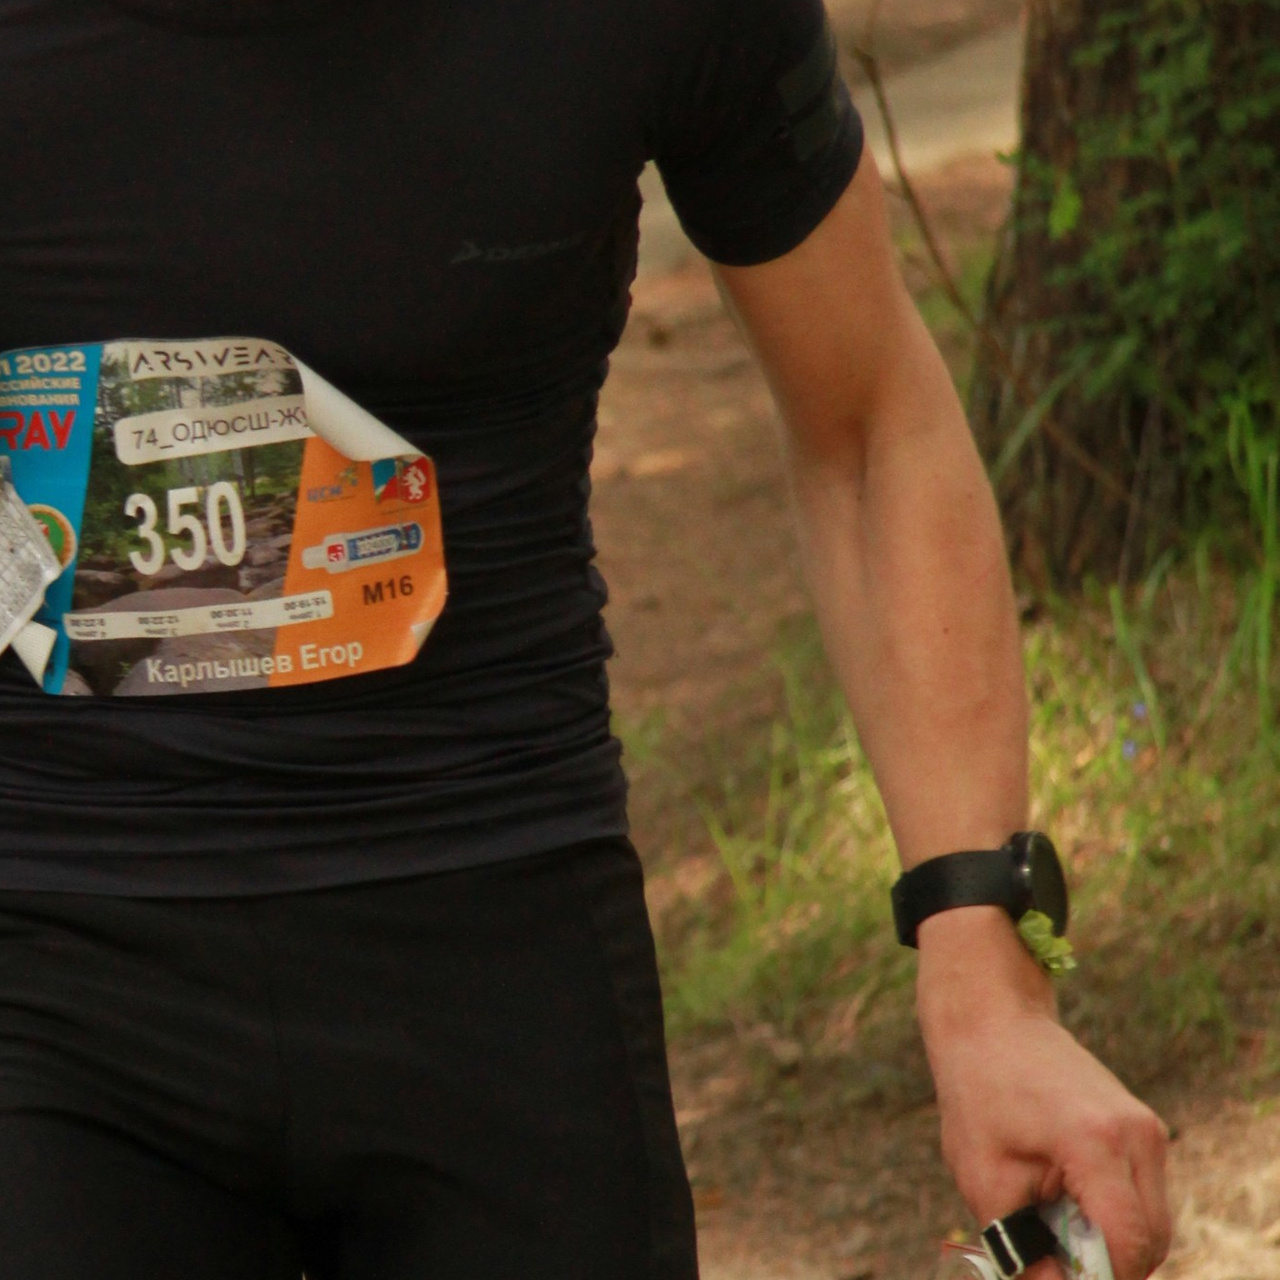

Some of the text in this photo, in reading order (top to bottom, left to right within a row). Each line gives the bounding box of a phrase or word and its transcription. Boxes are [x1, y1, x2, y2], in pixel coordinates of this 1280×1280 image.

[14, 350, 87, 374] 2022
[124, 480, 247, 576] 350
[146, 640, 364, 688] Карлышев Егор
